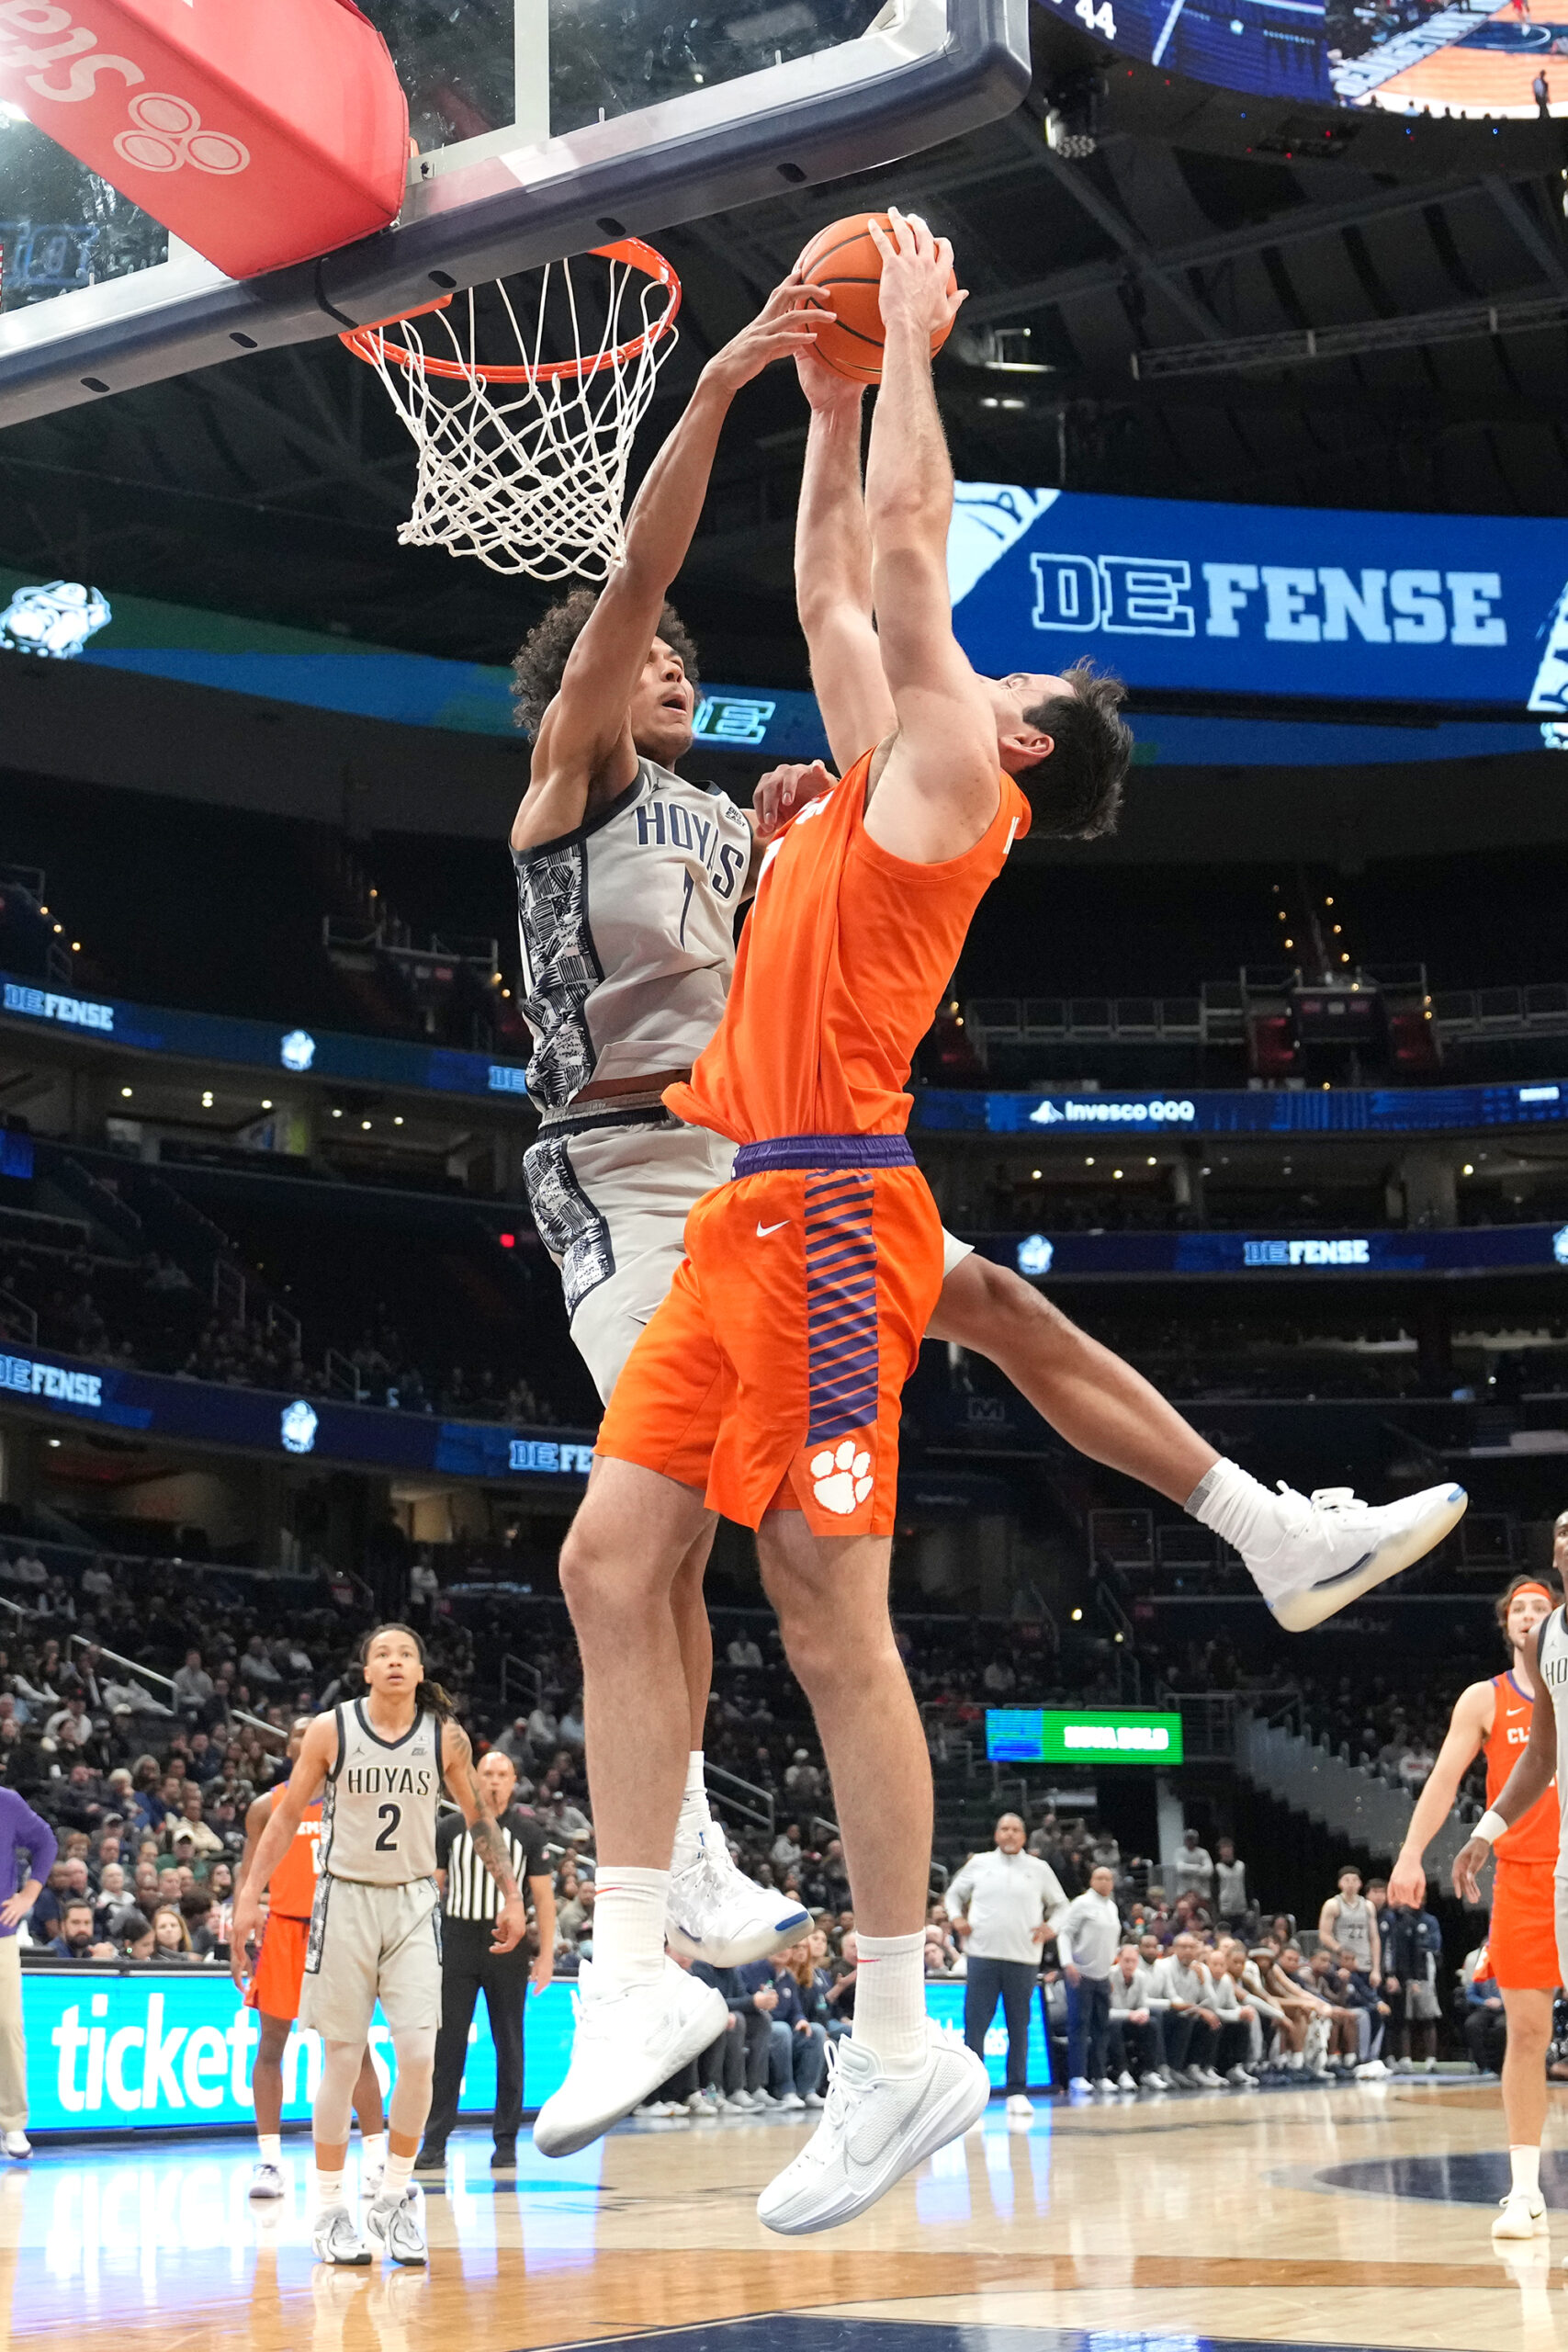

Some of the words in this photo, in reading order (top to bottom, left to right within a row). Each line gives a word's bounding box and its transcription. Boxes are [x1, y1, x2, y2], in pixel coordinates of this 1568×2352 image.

[1031, 552, 1508, 647] DEFENSE
[693, 695, 776, 745] E
[4, 982, 114, 1032] DEFENSE
[1064, 1101, 1148, 1122] Invesco
[1148, 1100, 1196, 1122] QQQ
[1243, 1238, 1371, 1266] DEFENSE
[347, 1766, 432, 1796] HOYAS
[375, 1802, 402, 1851] 2
